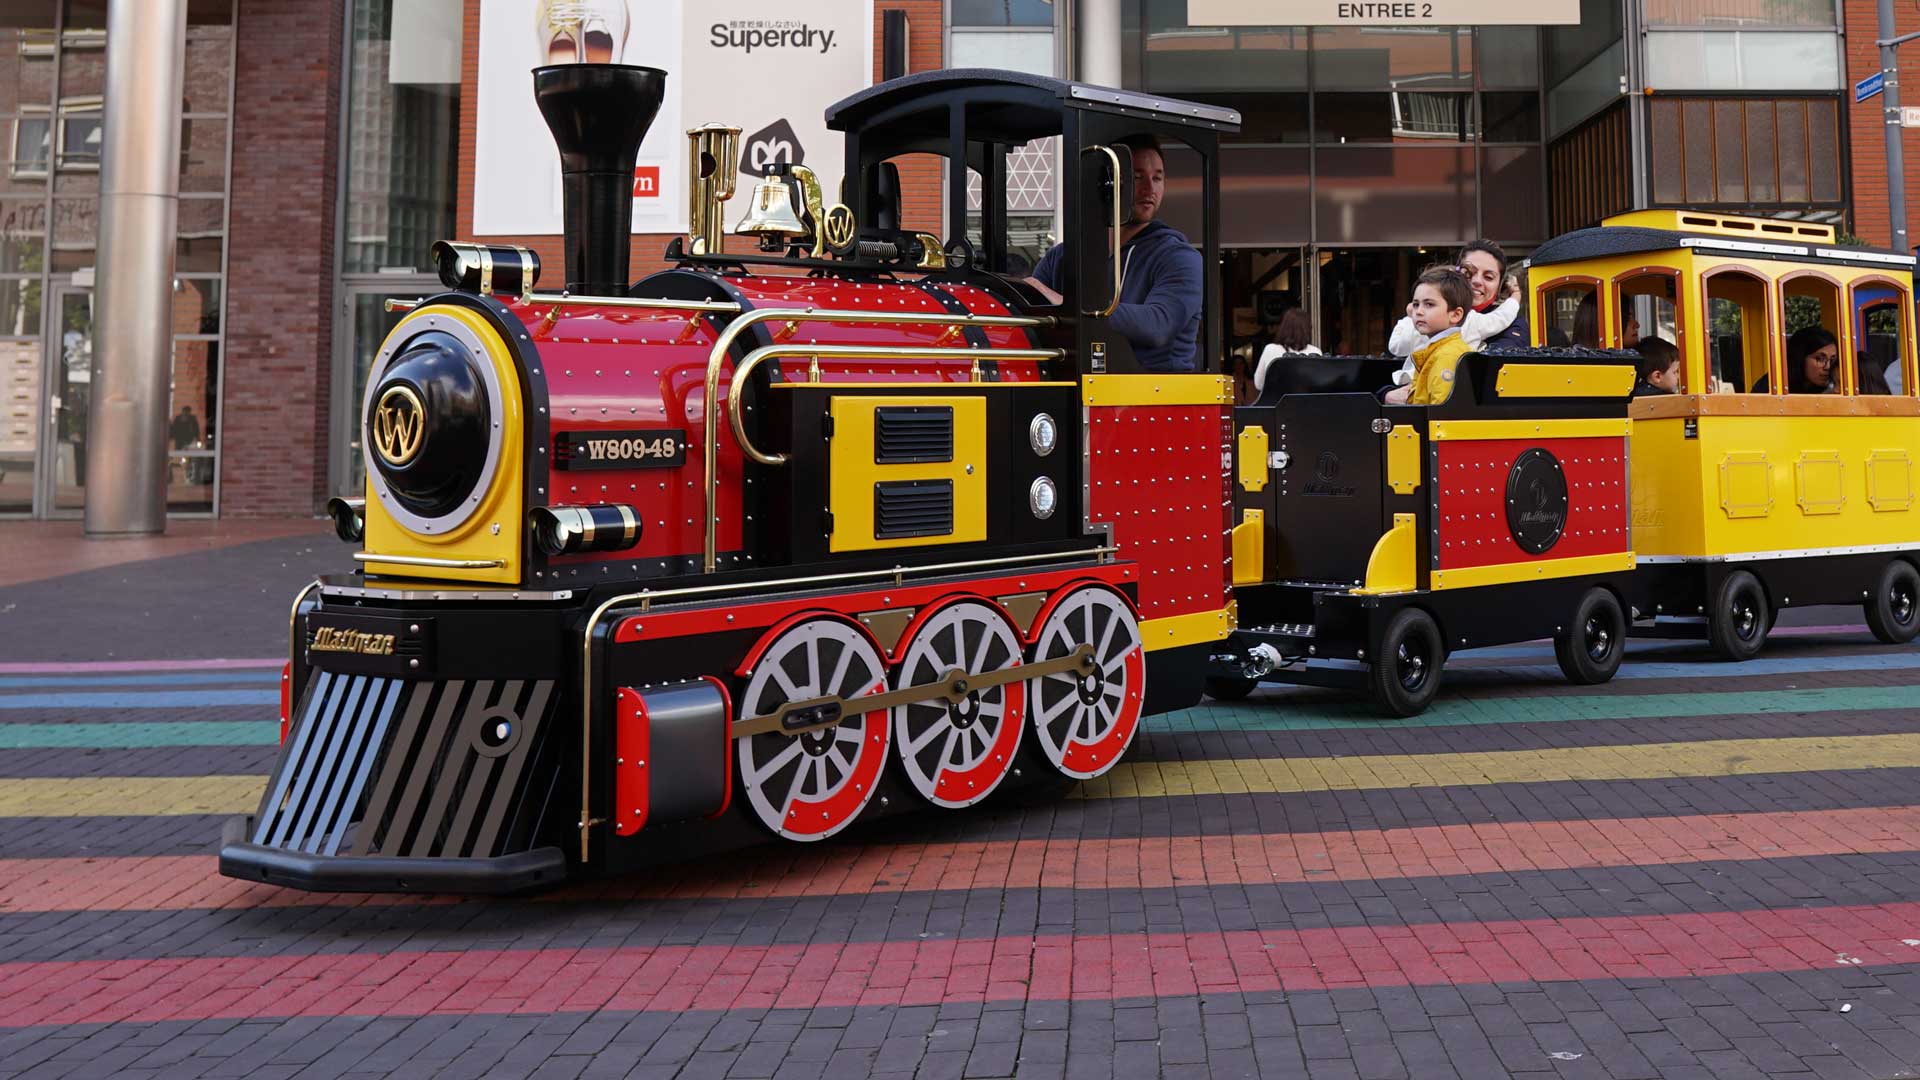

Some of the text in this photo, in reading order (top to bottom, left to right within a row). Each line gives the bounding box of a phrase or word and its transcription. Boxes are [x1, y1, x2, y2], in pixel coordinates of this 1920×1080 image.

[1338, 3, 1433, 18] ENTREE 2
[710, 23, 837, 53] Superdry.
[827, 209, 851, 245] W
[377, 402, 419, 458] W
[587, 438, 676, 460] W809-48
